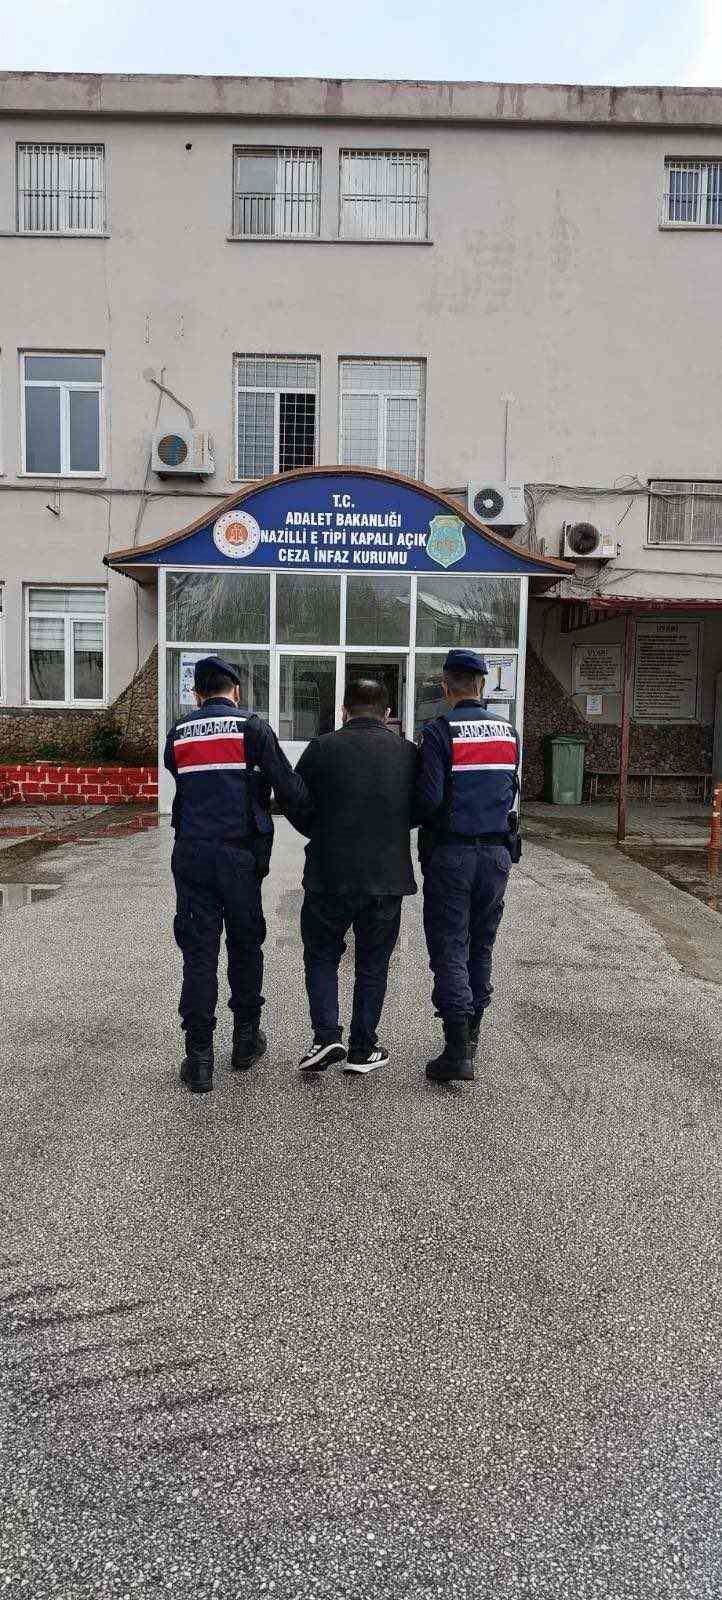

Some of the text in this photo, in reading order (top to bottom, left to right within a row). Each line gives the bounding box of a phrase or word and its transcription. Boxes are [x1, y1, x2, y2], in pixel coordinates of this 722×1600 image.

[332, 494, 355, 508] T.C.
[285, 511, 402, 527] ADALET BAKANLIĞI
[260, 528, 307, 544] NAZİLLİ
[310, 531, 318, 544] E
[321, 529, 346, 545] TİPİ
[350, 532, 393, 545] KAPALI
[396, 533, 427, 549] AÇIK
[278, 547, 408, 565] CEZA İNFAZ KURUMU
[181, 720, 239, 738] JANDARMA
[458, 724, 512, 738] JANDARMA
